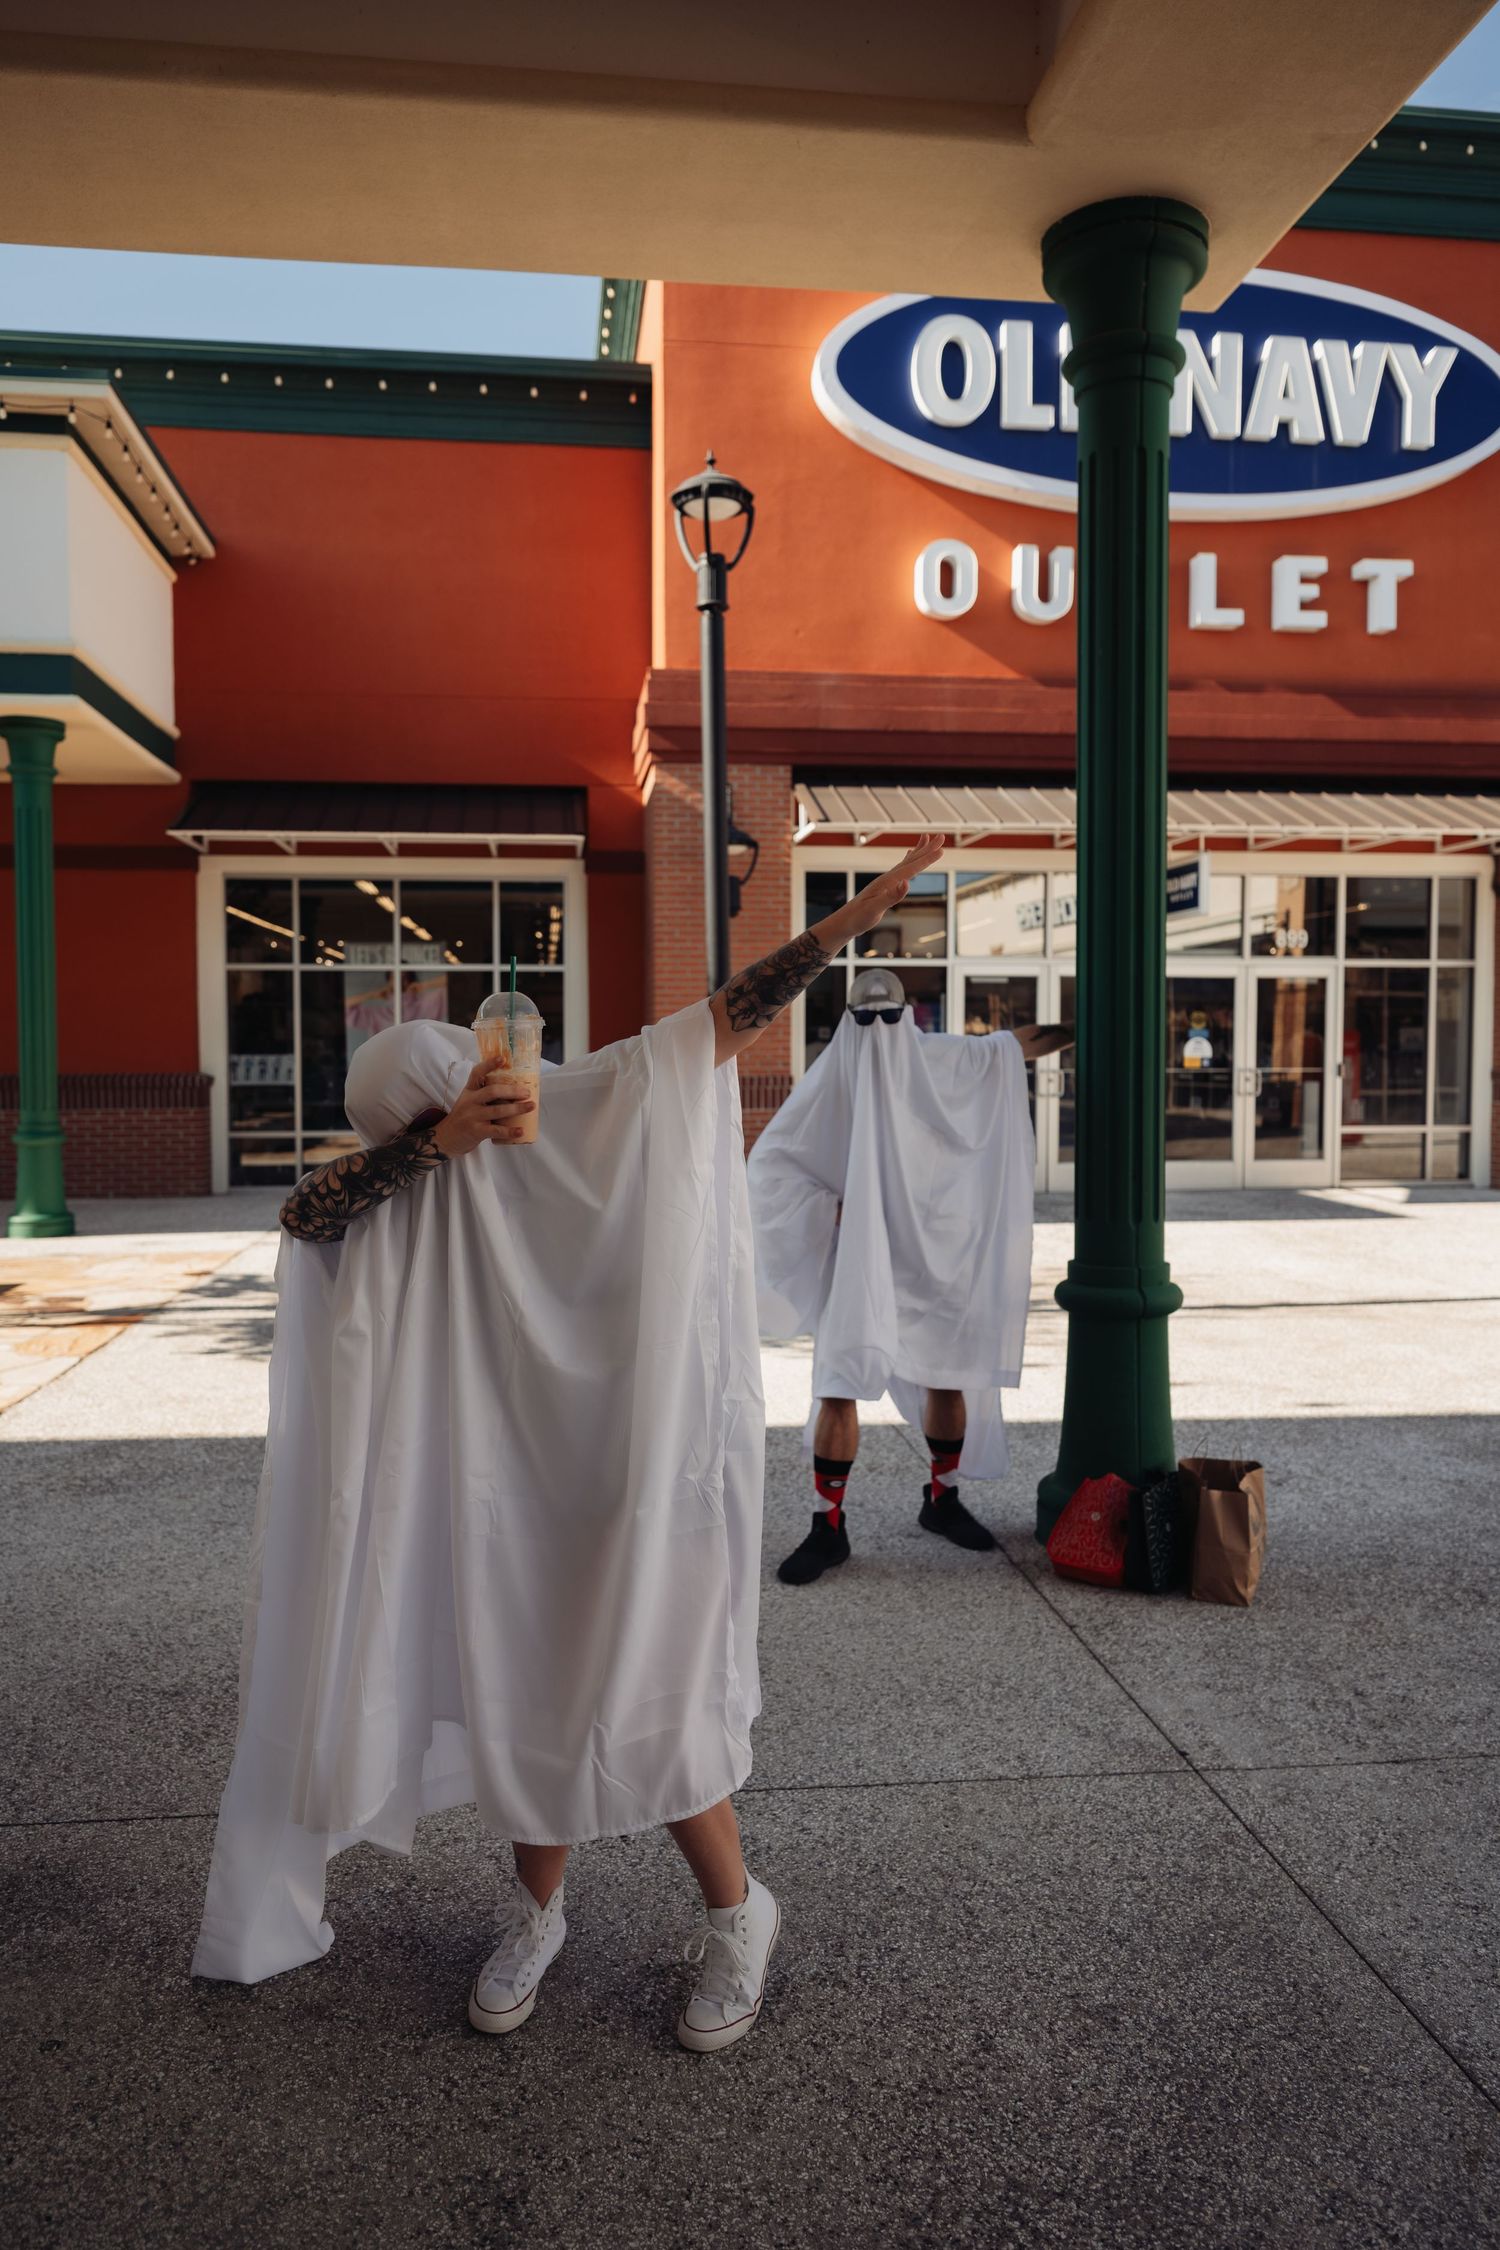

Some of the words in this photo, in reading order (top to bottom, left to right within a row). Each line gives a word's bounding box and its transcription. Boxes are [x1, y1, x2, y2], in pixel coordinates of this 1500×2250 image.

[911, 314, 1079, 432] OL
[1168, 328, 1459, 450] NAVY
[914, 538, 1414, 635] OULET
